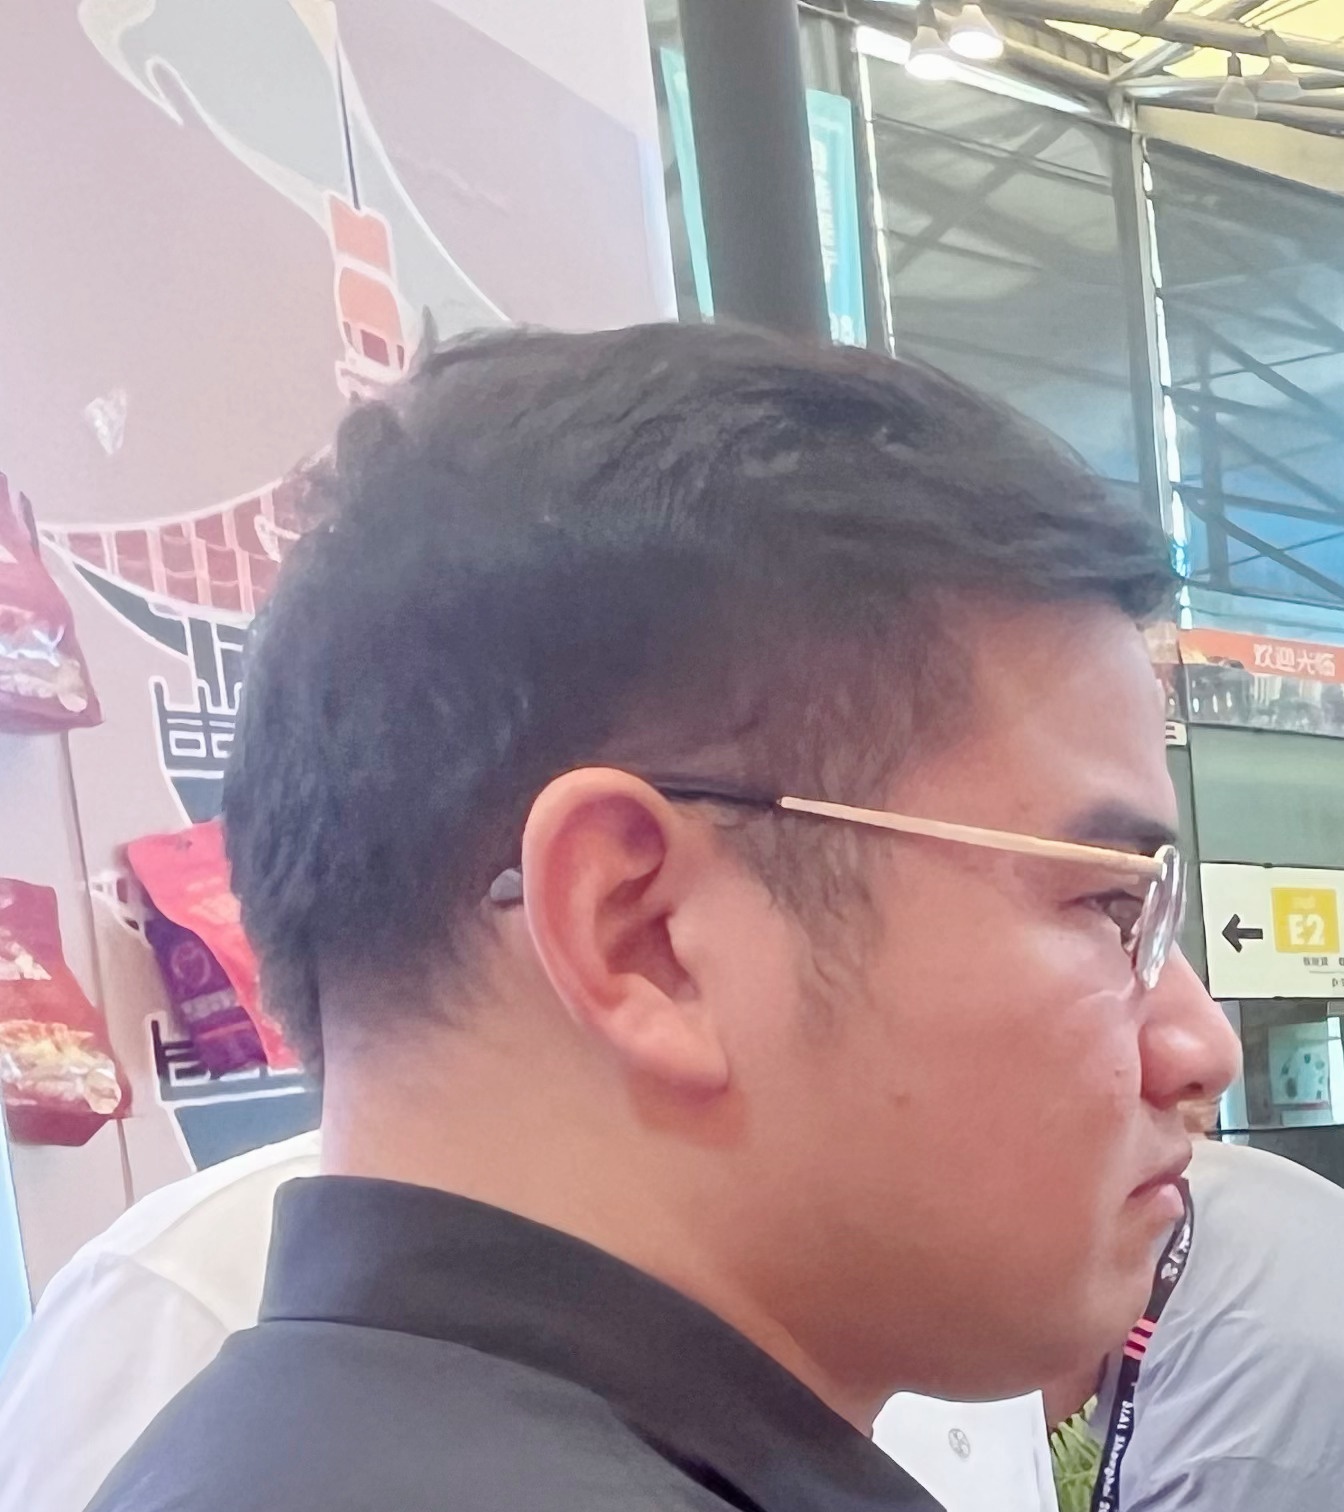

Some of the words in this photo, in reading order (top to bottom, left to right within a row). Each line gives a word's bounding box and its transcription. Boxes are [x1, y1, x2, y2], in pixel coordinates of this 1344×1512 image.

[1253, 643, 1337, 677] 欢迎光临
[1288, 914, 1326, 946] E2
